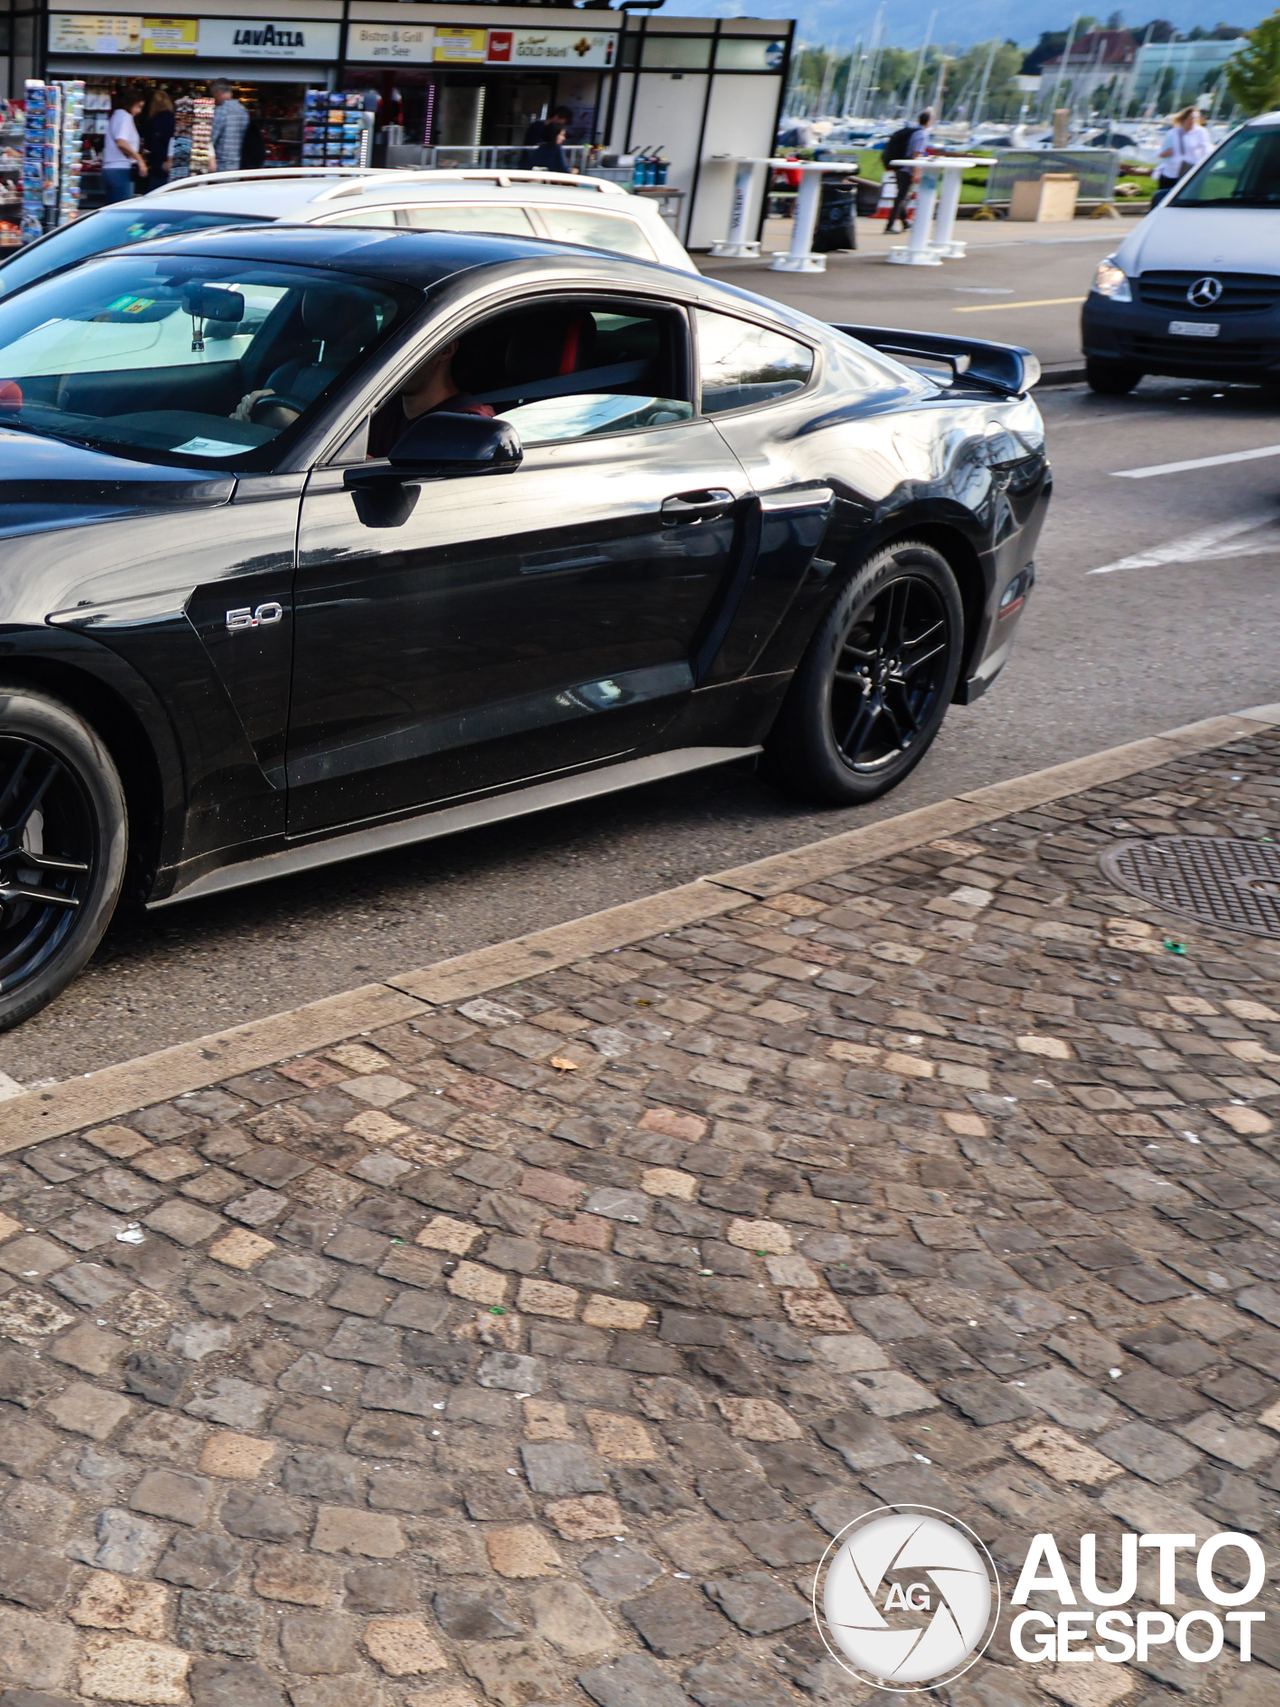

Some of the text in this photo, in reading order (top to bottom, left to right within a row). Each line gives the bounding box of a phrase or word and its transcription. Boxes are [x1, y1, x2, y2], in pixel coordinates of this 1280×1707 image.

[232, 24, 305, 47] LAVAZZA
[360, 30, 424, 43] Bistro & Grill
[372, 45, 410, 57] am See
[225, 601, 283, 631] 5.0
